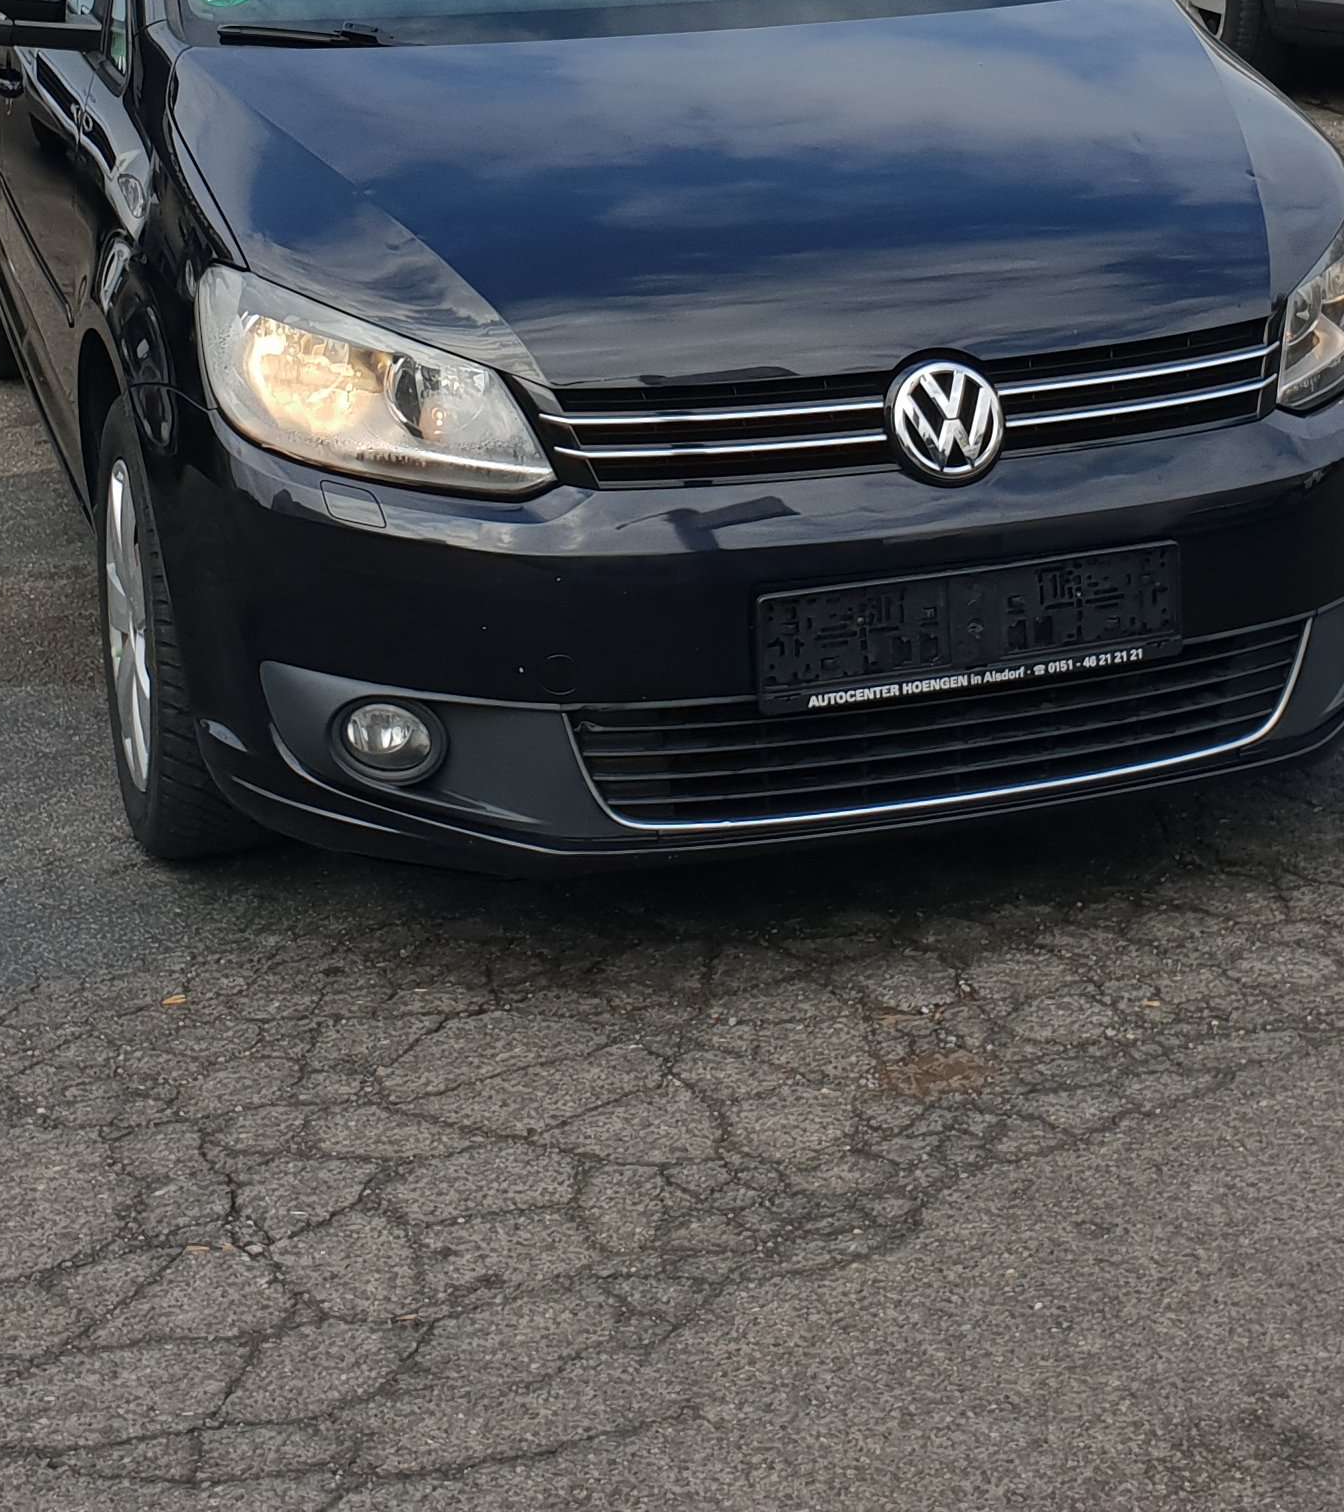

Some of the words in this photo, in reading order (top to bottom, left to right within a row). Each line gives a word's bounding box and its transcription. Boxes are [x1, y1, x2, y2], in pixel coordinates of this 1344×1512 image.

[808, 685, 900, 708] AUTOCENTER
[902, 675, 968, 695] HOENGEN
[970, 673, 982, 685] in
[983, 666, 1025, 683] Alsdorf
[1048, 659, 1073, 674] 0151
[1098, 653, 1112, 666] 21
[1114, 650, 1128, 664] 21
[1130, 648, 1143, 662] 21
